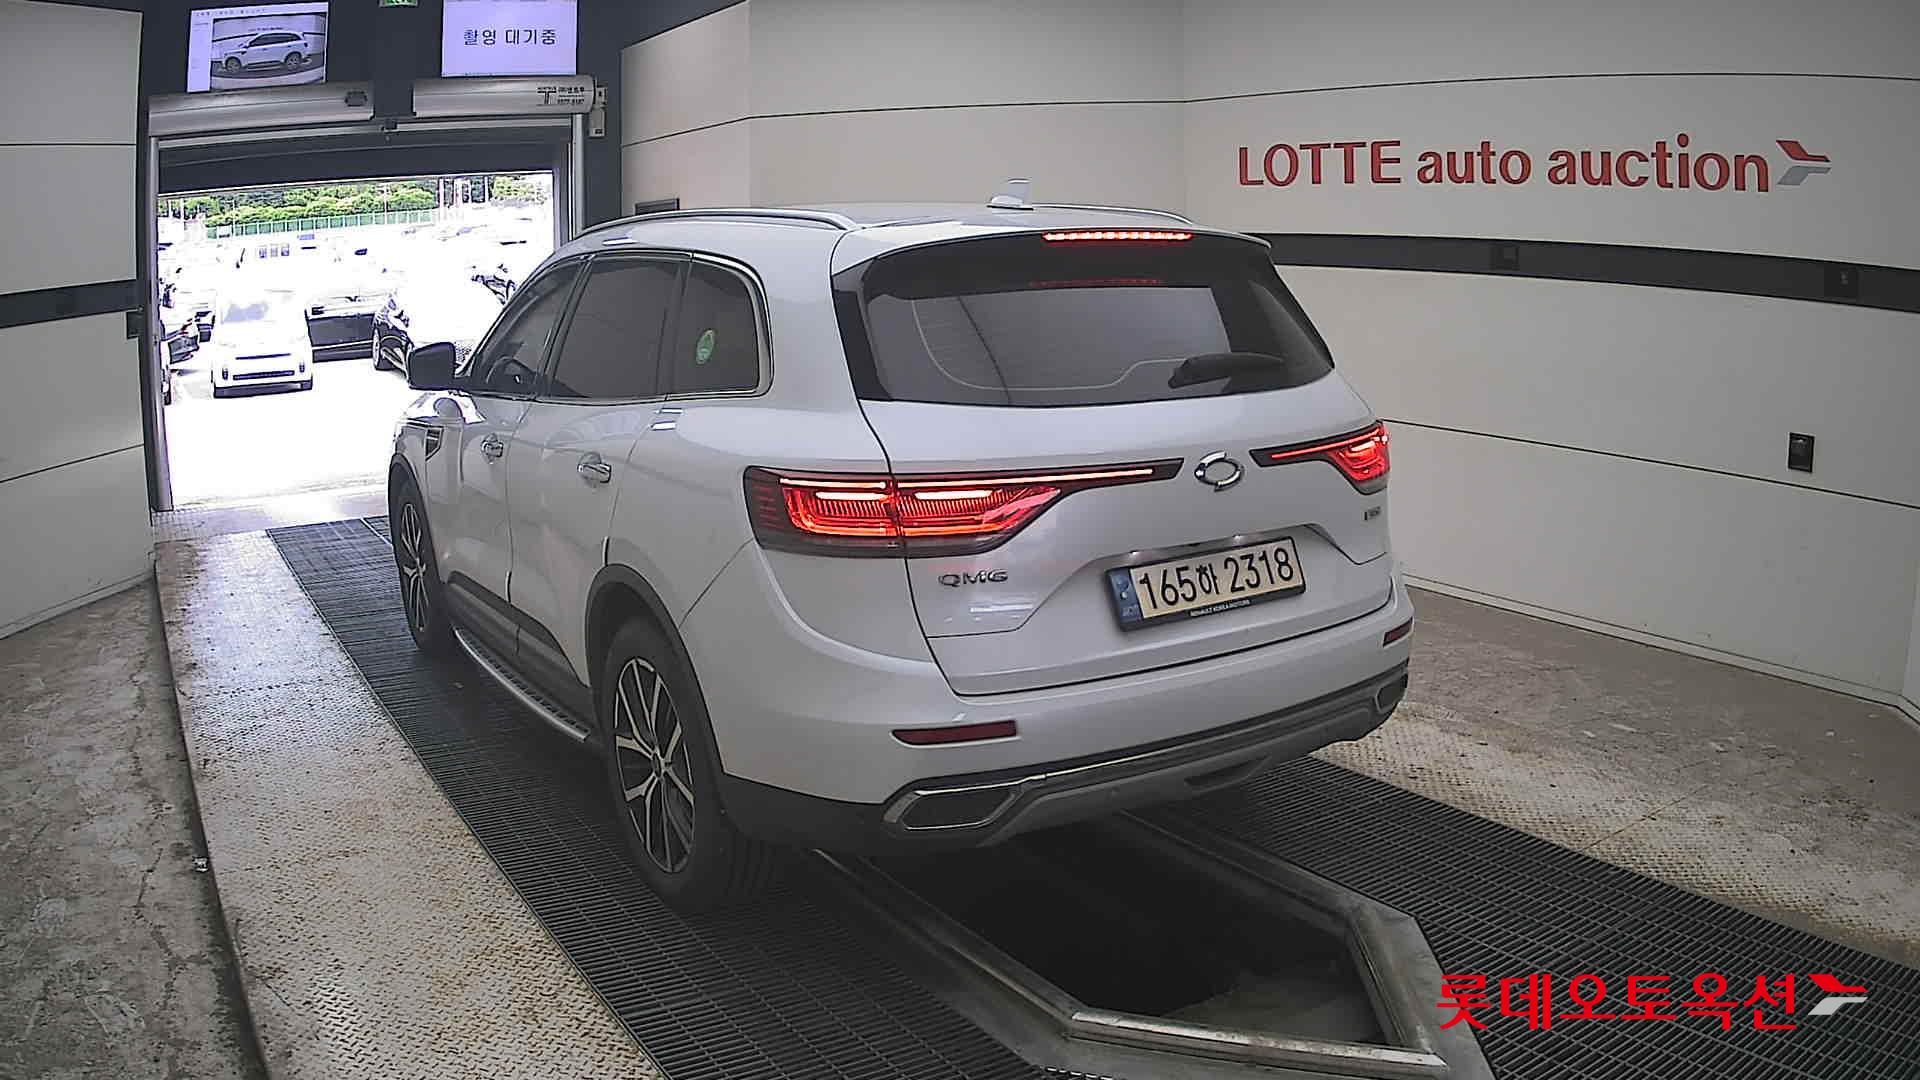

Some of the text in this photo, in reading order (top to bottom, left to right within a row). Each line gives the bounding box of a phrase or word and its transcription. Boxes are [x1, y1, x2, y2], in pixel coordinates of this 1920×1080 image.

[505, 29, 556, 45] 대기중
[1238, 132, 1770, 193] LOTTE auto auction
[1139, 547, 1294, 610] 165하 2318
